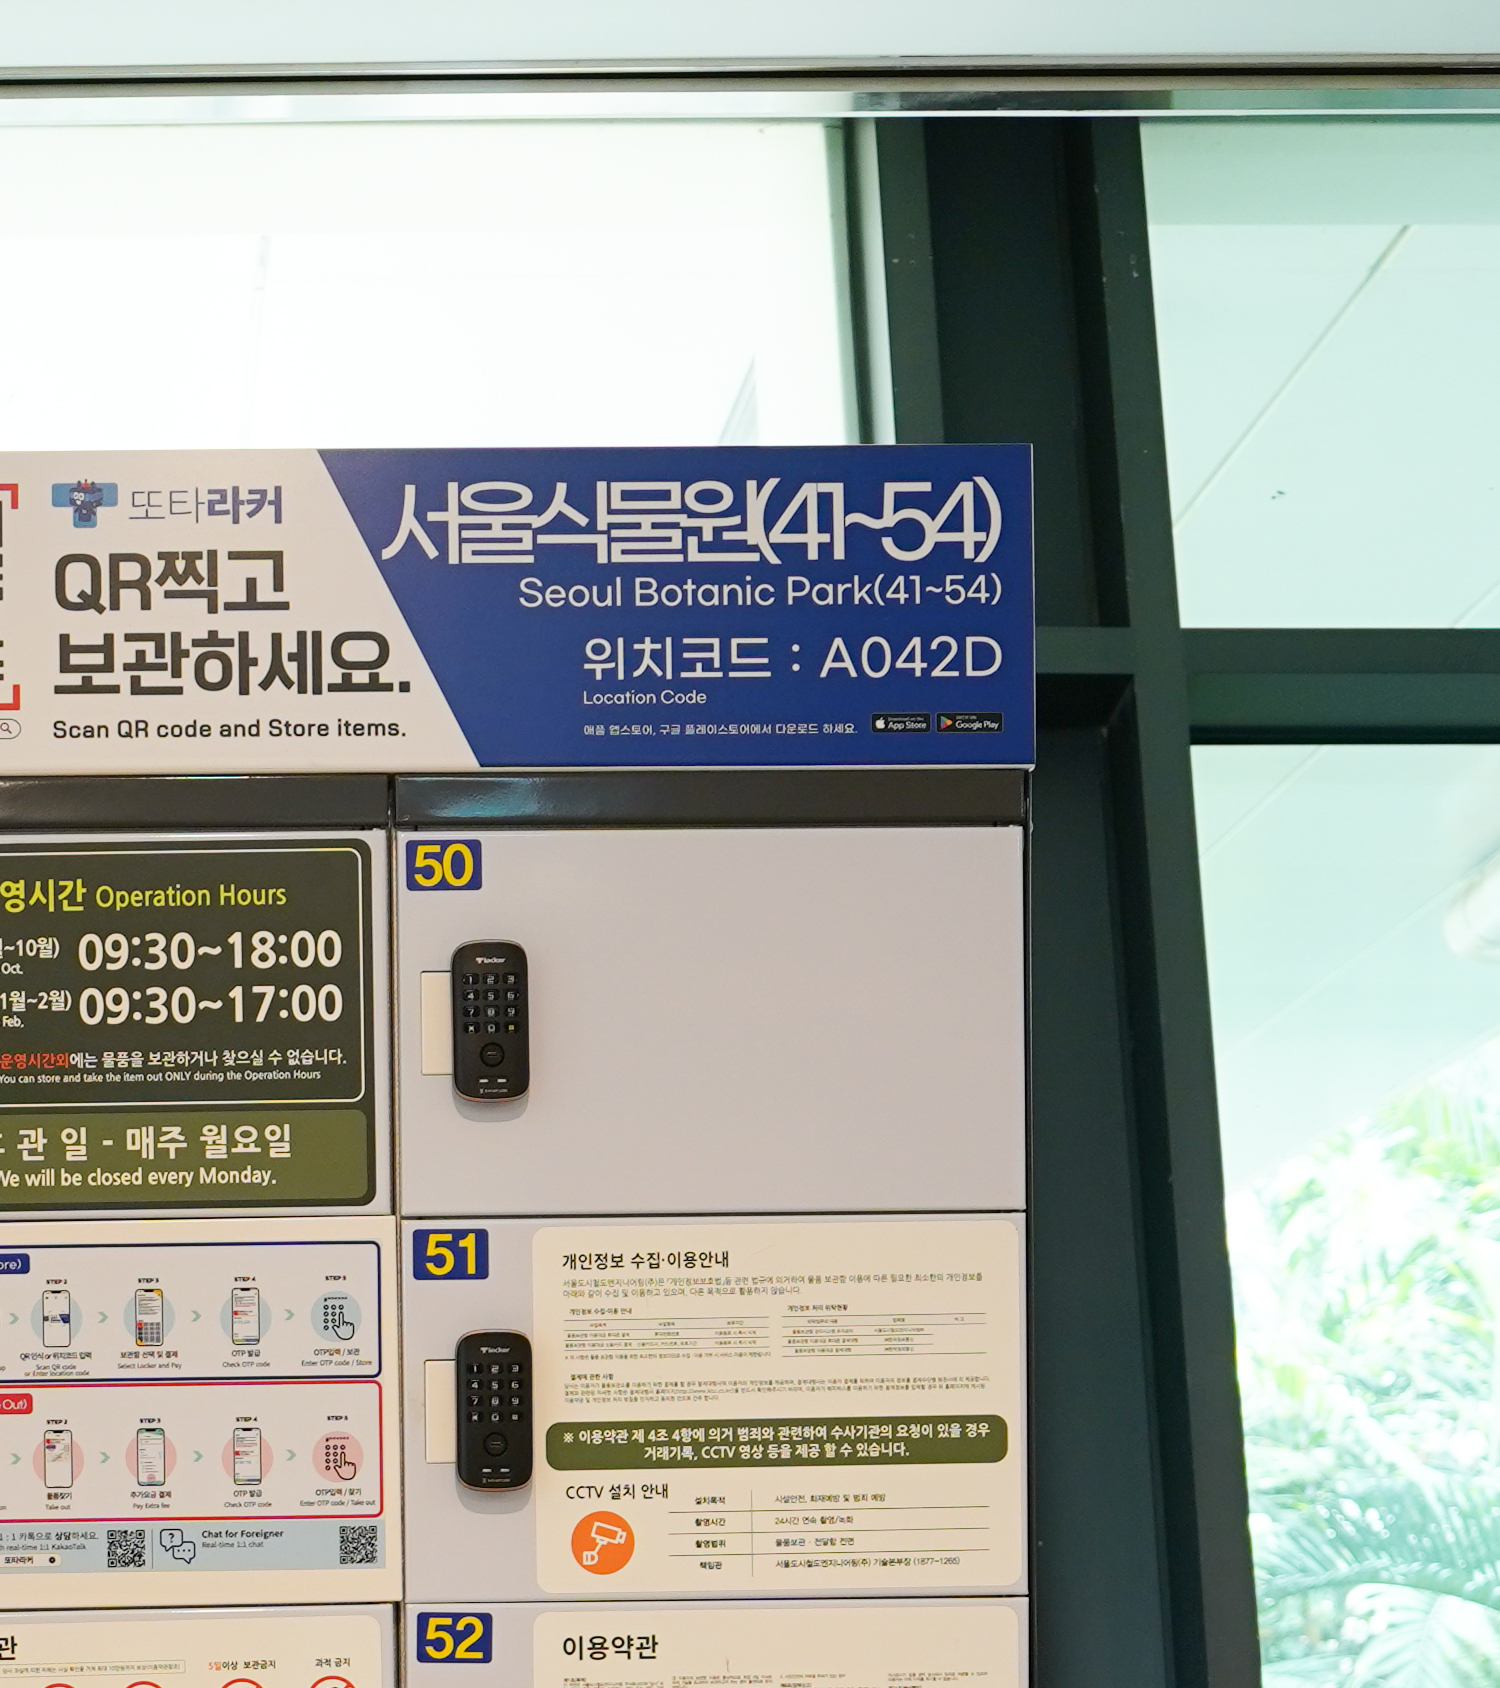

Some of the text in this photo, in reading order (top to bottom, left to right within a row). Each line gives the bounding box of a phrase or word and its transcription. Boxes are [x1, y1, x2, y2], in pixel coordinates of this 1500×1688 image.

[128, 486, 282, 524] 또타라커
[382, 476, 1002, 565] 서울식물원(41~54)
[54, 550, 289, 614] QR찍고
[519, 573, 1002, 607] Seoul Botanic Park(41~54)
[54, 631, 410, 696] 보관하세요.
[584, 635, 1002, 681] 위치코드 A042D
[583, 689, 707, 706] Location Code
[53, 718, 406, 739] Scan QR code and Store items.
[888, 720, 928, 731] App Store
[956, 719, 1000, 731] Google Play
[414, 843, 474, 887] 50
[96, 882, 210, 911] Operation
[220, 883, 287, 906] Hours
[78, 930, 342, 971] 09:30~18:00
[79, 984, 342, 1025] 09:30~17:00
[102, 1052, 144, 1068] 물품을
[148, 1051, 218, 1068] 보관하거나
[222, 1050, 263, 1067] 찾으실
[268, 1050, 282, 1066] 수
[286, 1048, 347, 1066] 없습니다.
[19, 1075, 35, 1083] can
[37, 1074, 60, 1083] store
[63, 1073, 81, 1083] and
[84, 1072, 103, 1082] take
[106, 1072, 121, 1082] the
[124, 1072, 144, 1082] item
[147, 1073, 162, 1082] out
[165, 1072, 191, 1081] ONLY
[194, 1071, 224, 1083] during
[227, 1071, 242, 1081] the
[245, 1070, 291, 1083] Operation
[294, 1070, 321, 1080] Hours
[17, 1127, 48, 1161] 관
[62, 1126, 88, 1161] 일
[126, 1124, 188, 1159] 매주
[200, 1123, 292, 1159] 월요일
[25, 1167, 55, 1187] will
[61, 1167, 82, 1186] be
[87, 1166, 142, 1186] closed
[148, 1168, 193, 1189] every
[200, 1164, 276, 1188] Monday.
[425, 1233, 480, 1276] 51
[562, 1250, 730, 1271] 개인정보 수집·이용안내
[2, 1399, 28, 1411] Out)
[579, 1422, 990, 1444] 이용약관 제 4조 4항에 의거 범죄와 관련하여 수사기관의 요청이 있을 경우
[643, 1441, 910, 1461] 거래기록, CCTV 영상 등을 제공 할 수 있습니다.
[566, 1482, 669, 1500] CCTV 설치 안내
[202, 1529, 284, 1539] Chat for Foreigner
[424, 1617, 484, 1660] 52
[563, 1634, 658, 1661] 이용약관
